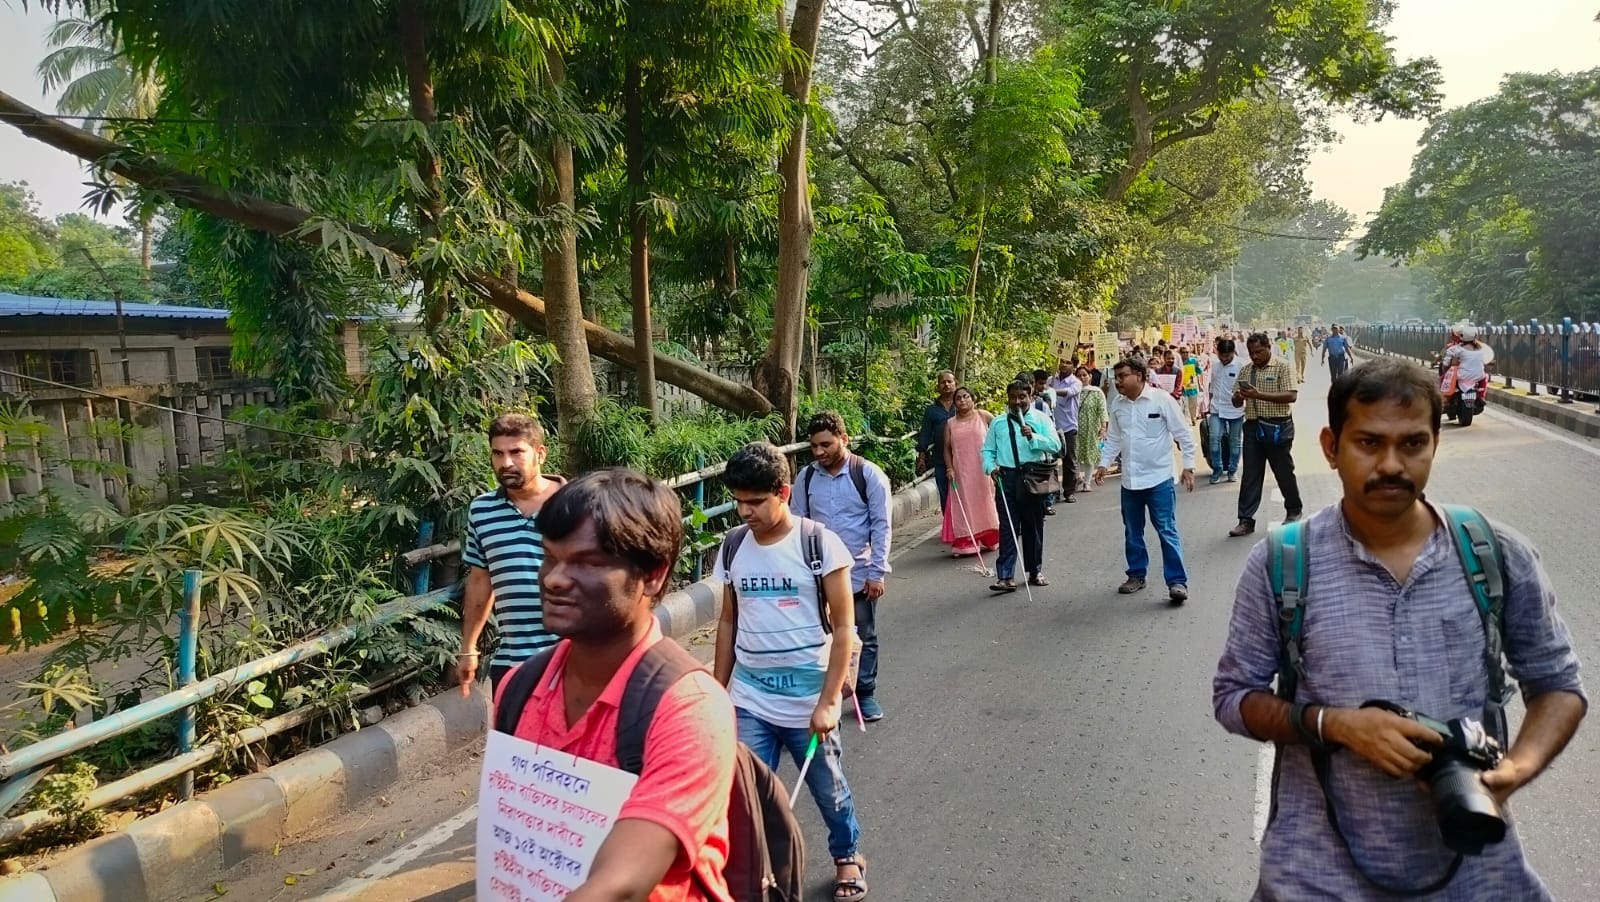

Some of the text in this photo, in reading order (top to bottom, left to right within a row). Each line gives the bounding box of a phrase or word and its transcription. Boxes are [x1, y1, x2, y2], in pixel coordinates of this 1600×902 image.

[741, 577, 792, 592] BERLN
[750, 673, 797, 689] CIAL
[511, 755, 590, 795] গণ পরিবহনে
